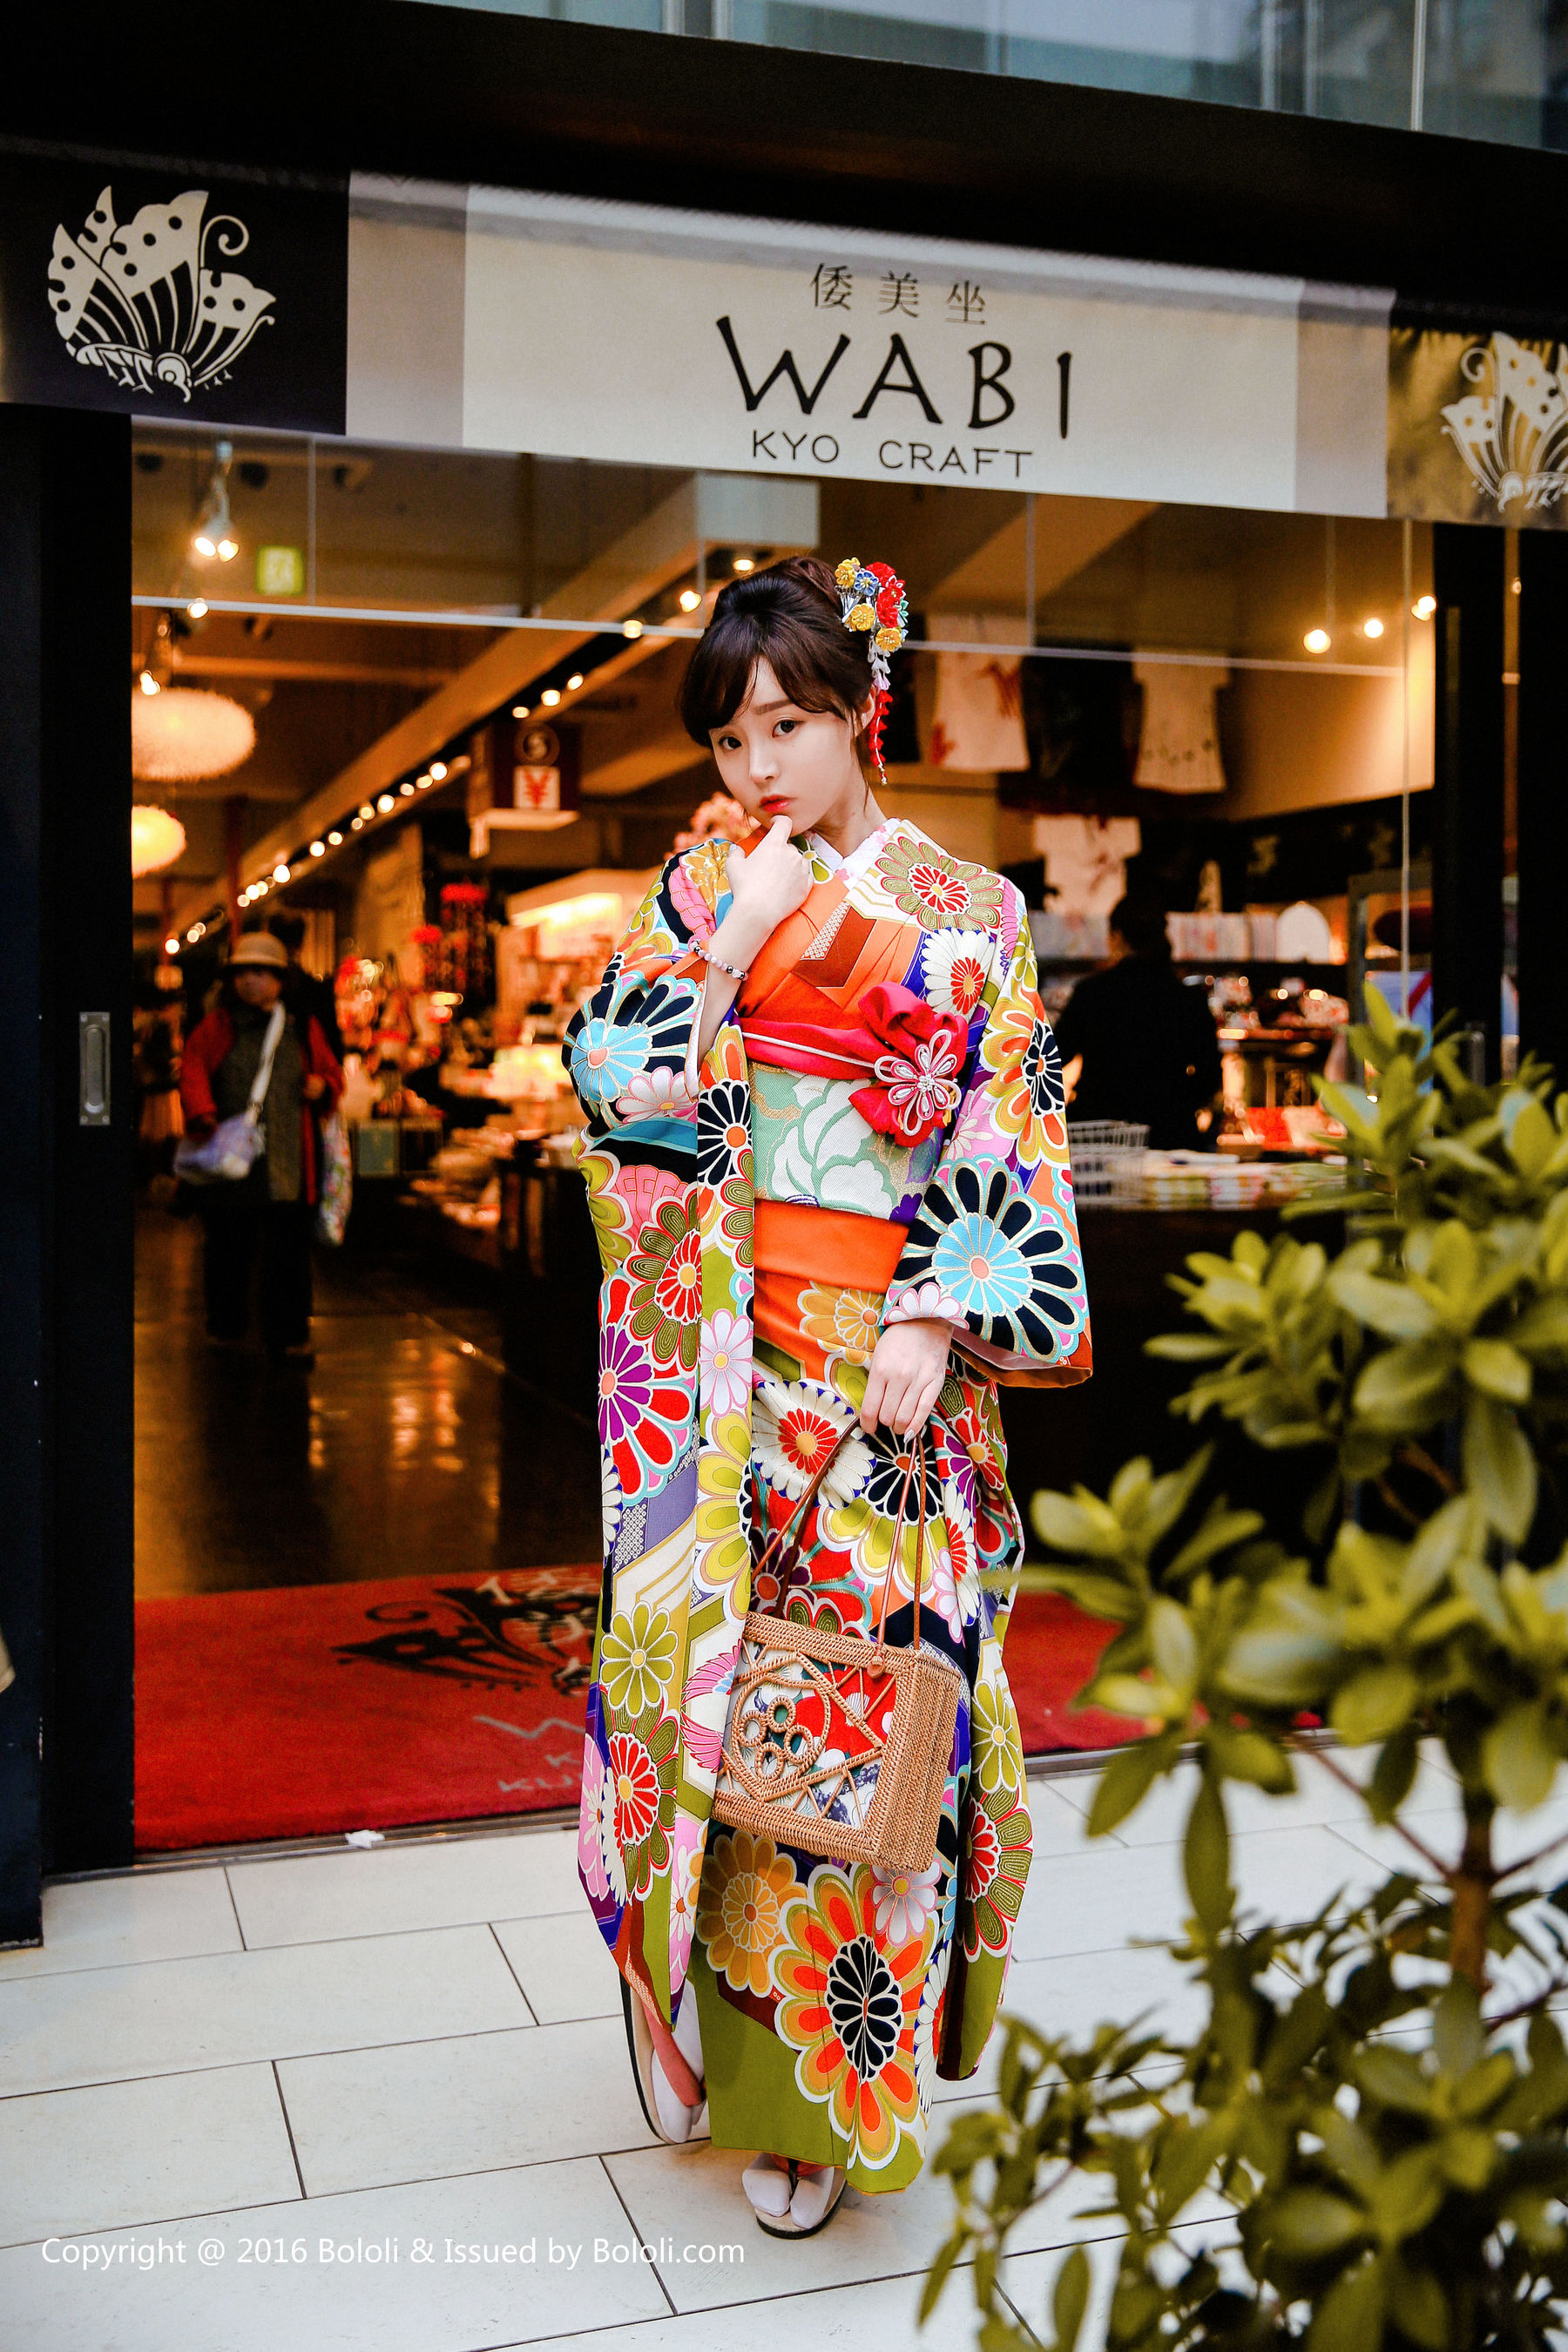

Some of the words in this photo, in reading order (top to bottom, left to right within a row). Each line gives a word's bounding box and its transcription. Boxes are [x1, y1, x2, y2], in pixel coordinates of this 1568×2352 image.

[810, 262, 986, 326] 倭美坐
[716, 314, 1072, 440] WABI
[752, 429, 841, 464] KYO
[878, 439, 1033, 478] CRAFT
